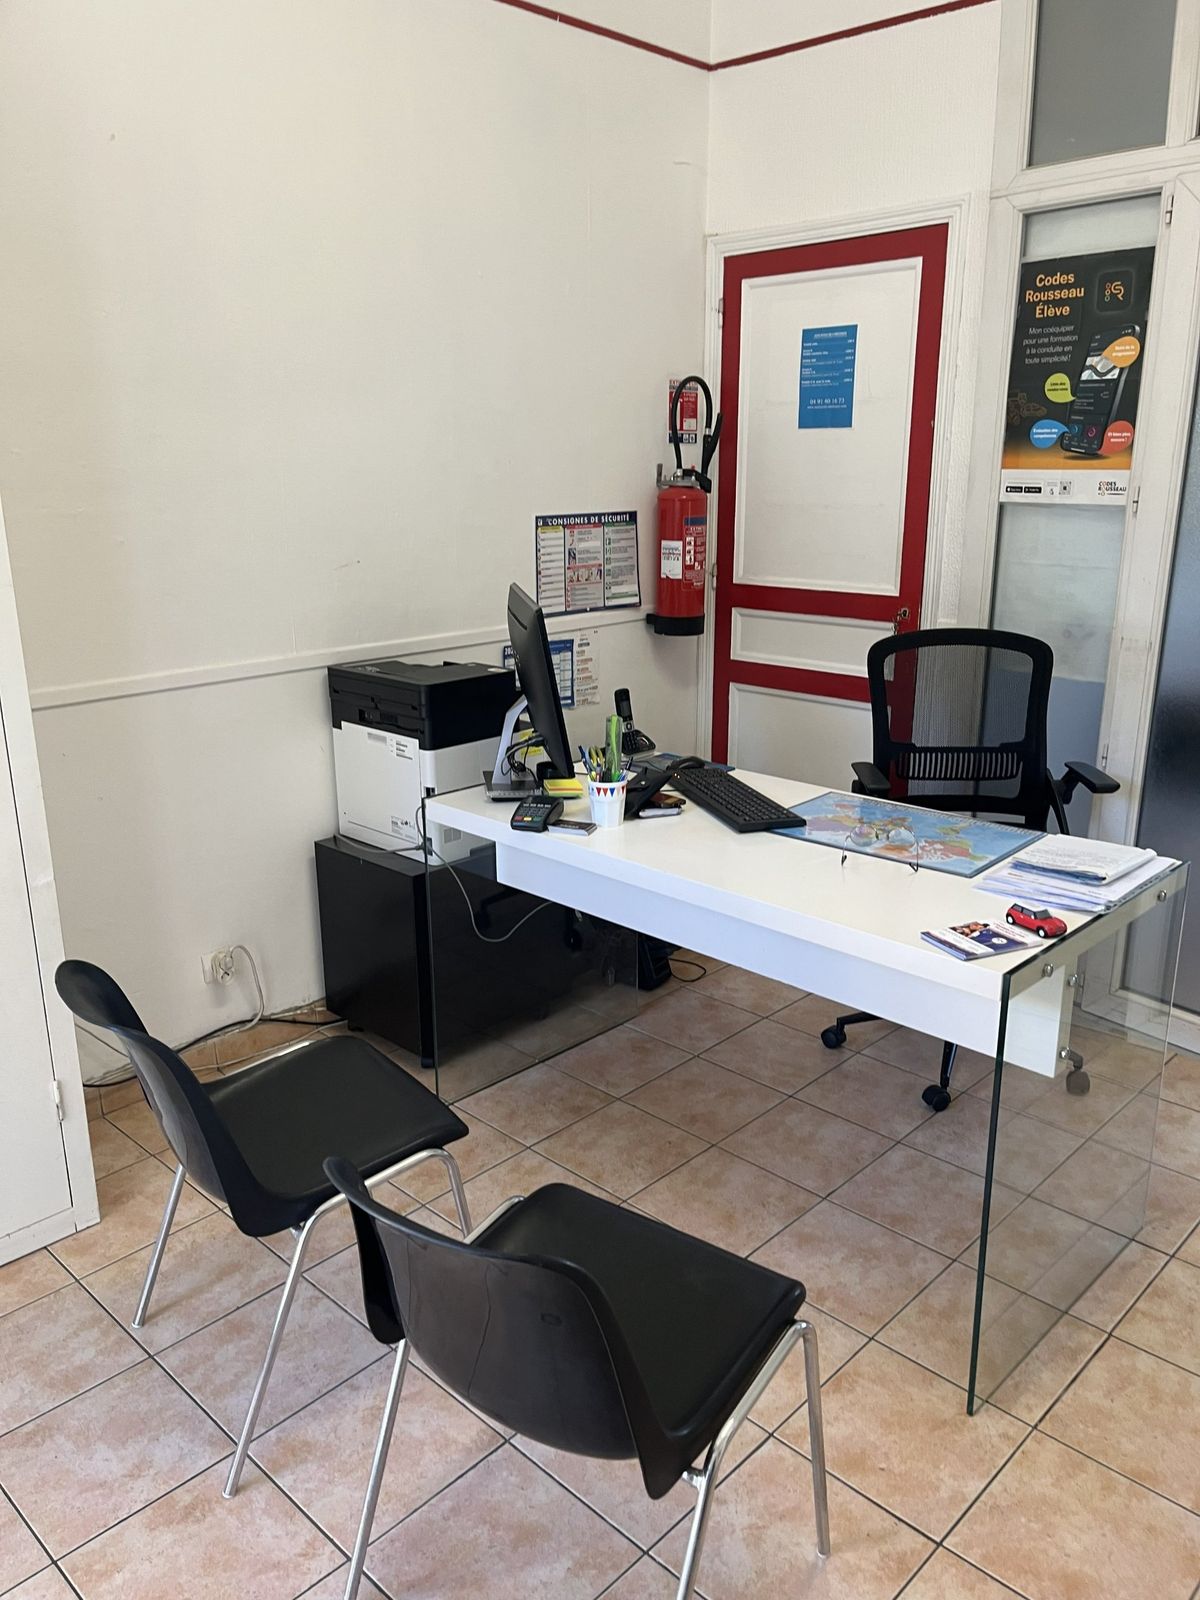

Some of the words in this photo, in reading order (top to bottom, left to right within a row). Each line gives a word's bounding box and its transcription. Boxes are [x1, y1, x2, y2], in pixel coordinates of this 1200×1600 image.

[1036, 272, 1075, 287] Codes
[1025, 288, 1084, 303] Rousseau
[1035, 302, 1070, 318] Élève
[1043, 325, 1075, 334] coéquipier
[548, 516, 588, 526] CONSIGNES
[602, 513, 629, 522] SÉCURITÉ
